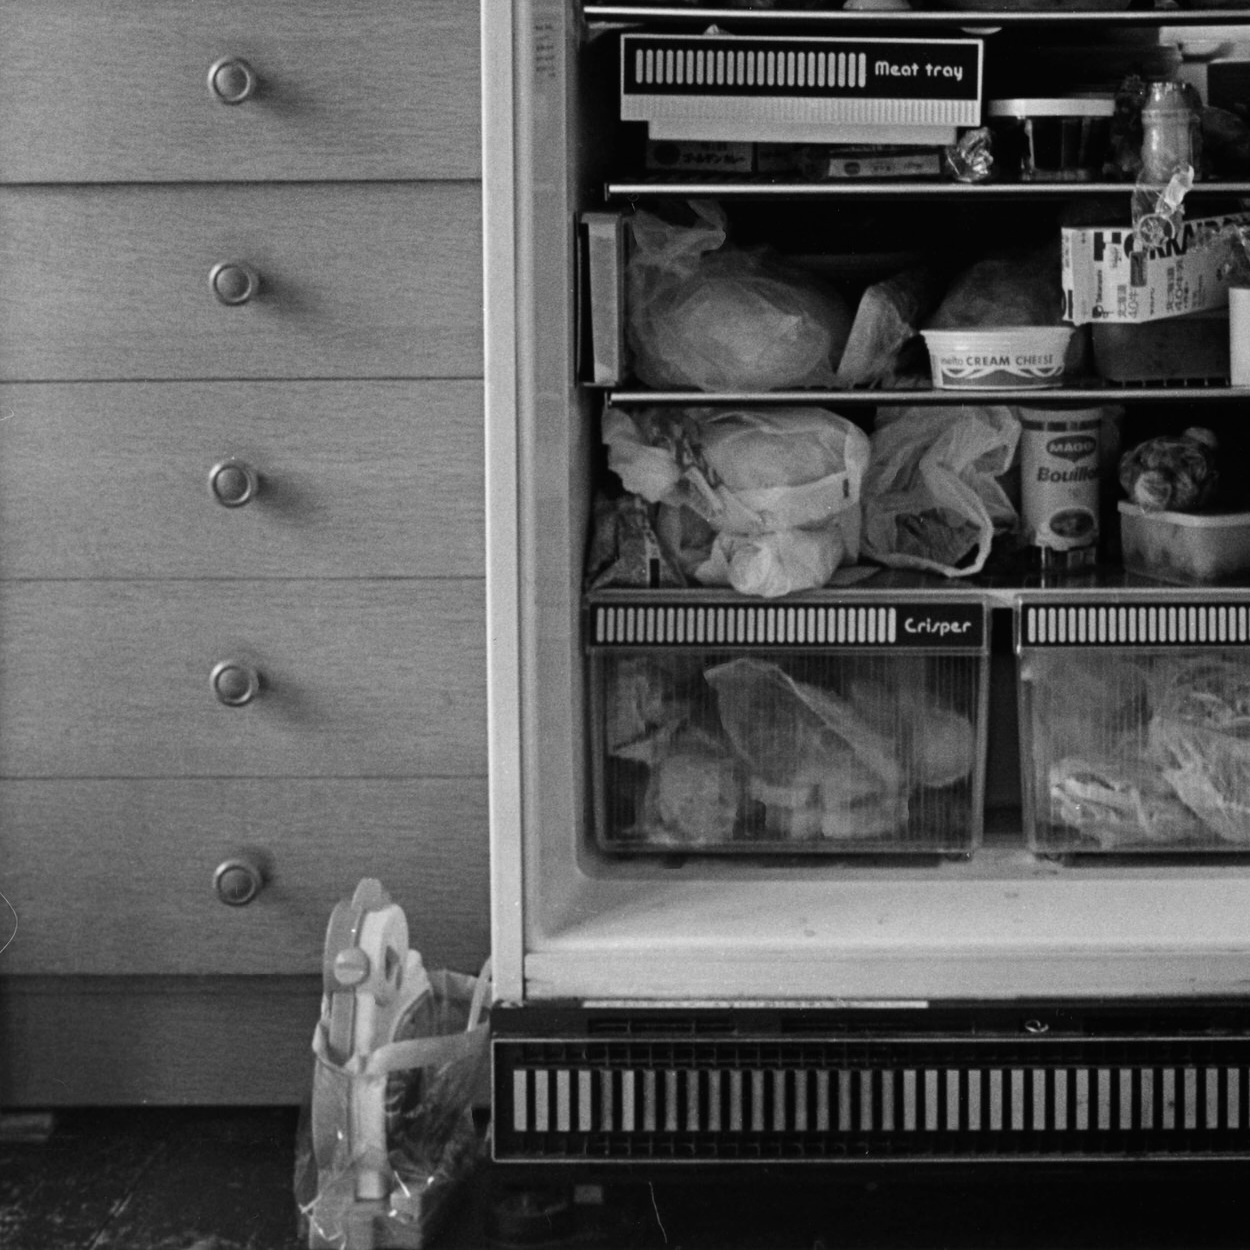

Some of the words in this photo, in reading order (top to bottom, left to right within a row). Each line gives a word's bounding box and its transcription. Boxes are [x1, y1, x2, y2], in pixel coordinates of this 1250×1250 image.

[874, 60, 919, 77] Meat
[925, 62, 963, 81] tray
[966, 355, 1010, 366] CREAM
[904, 617, 972, 634] Crisper
